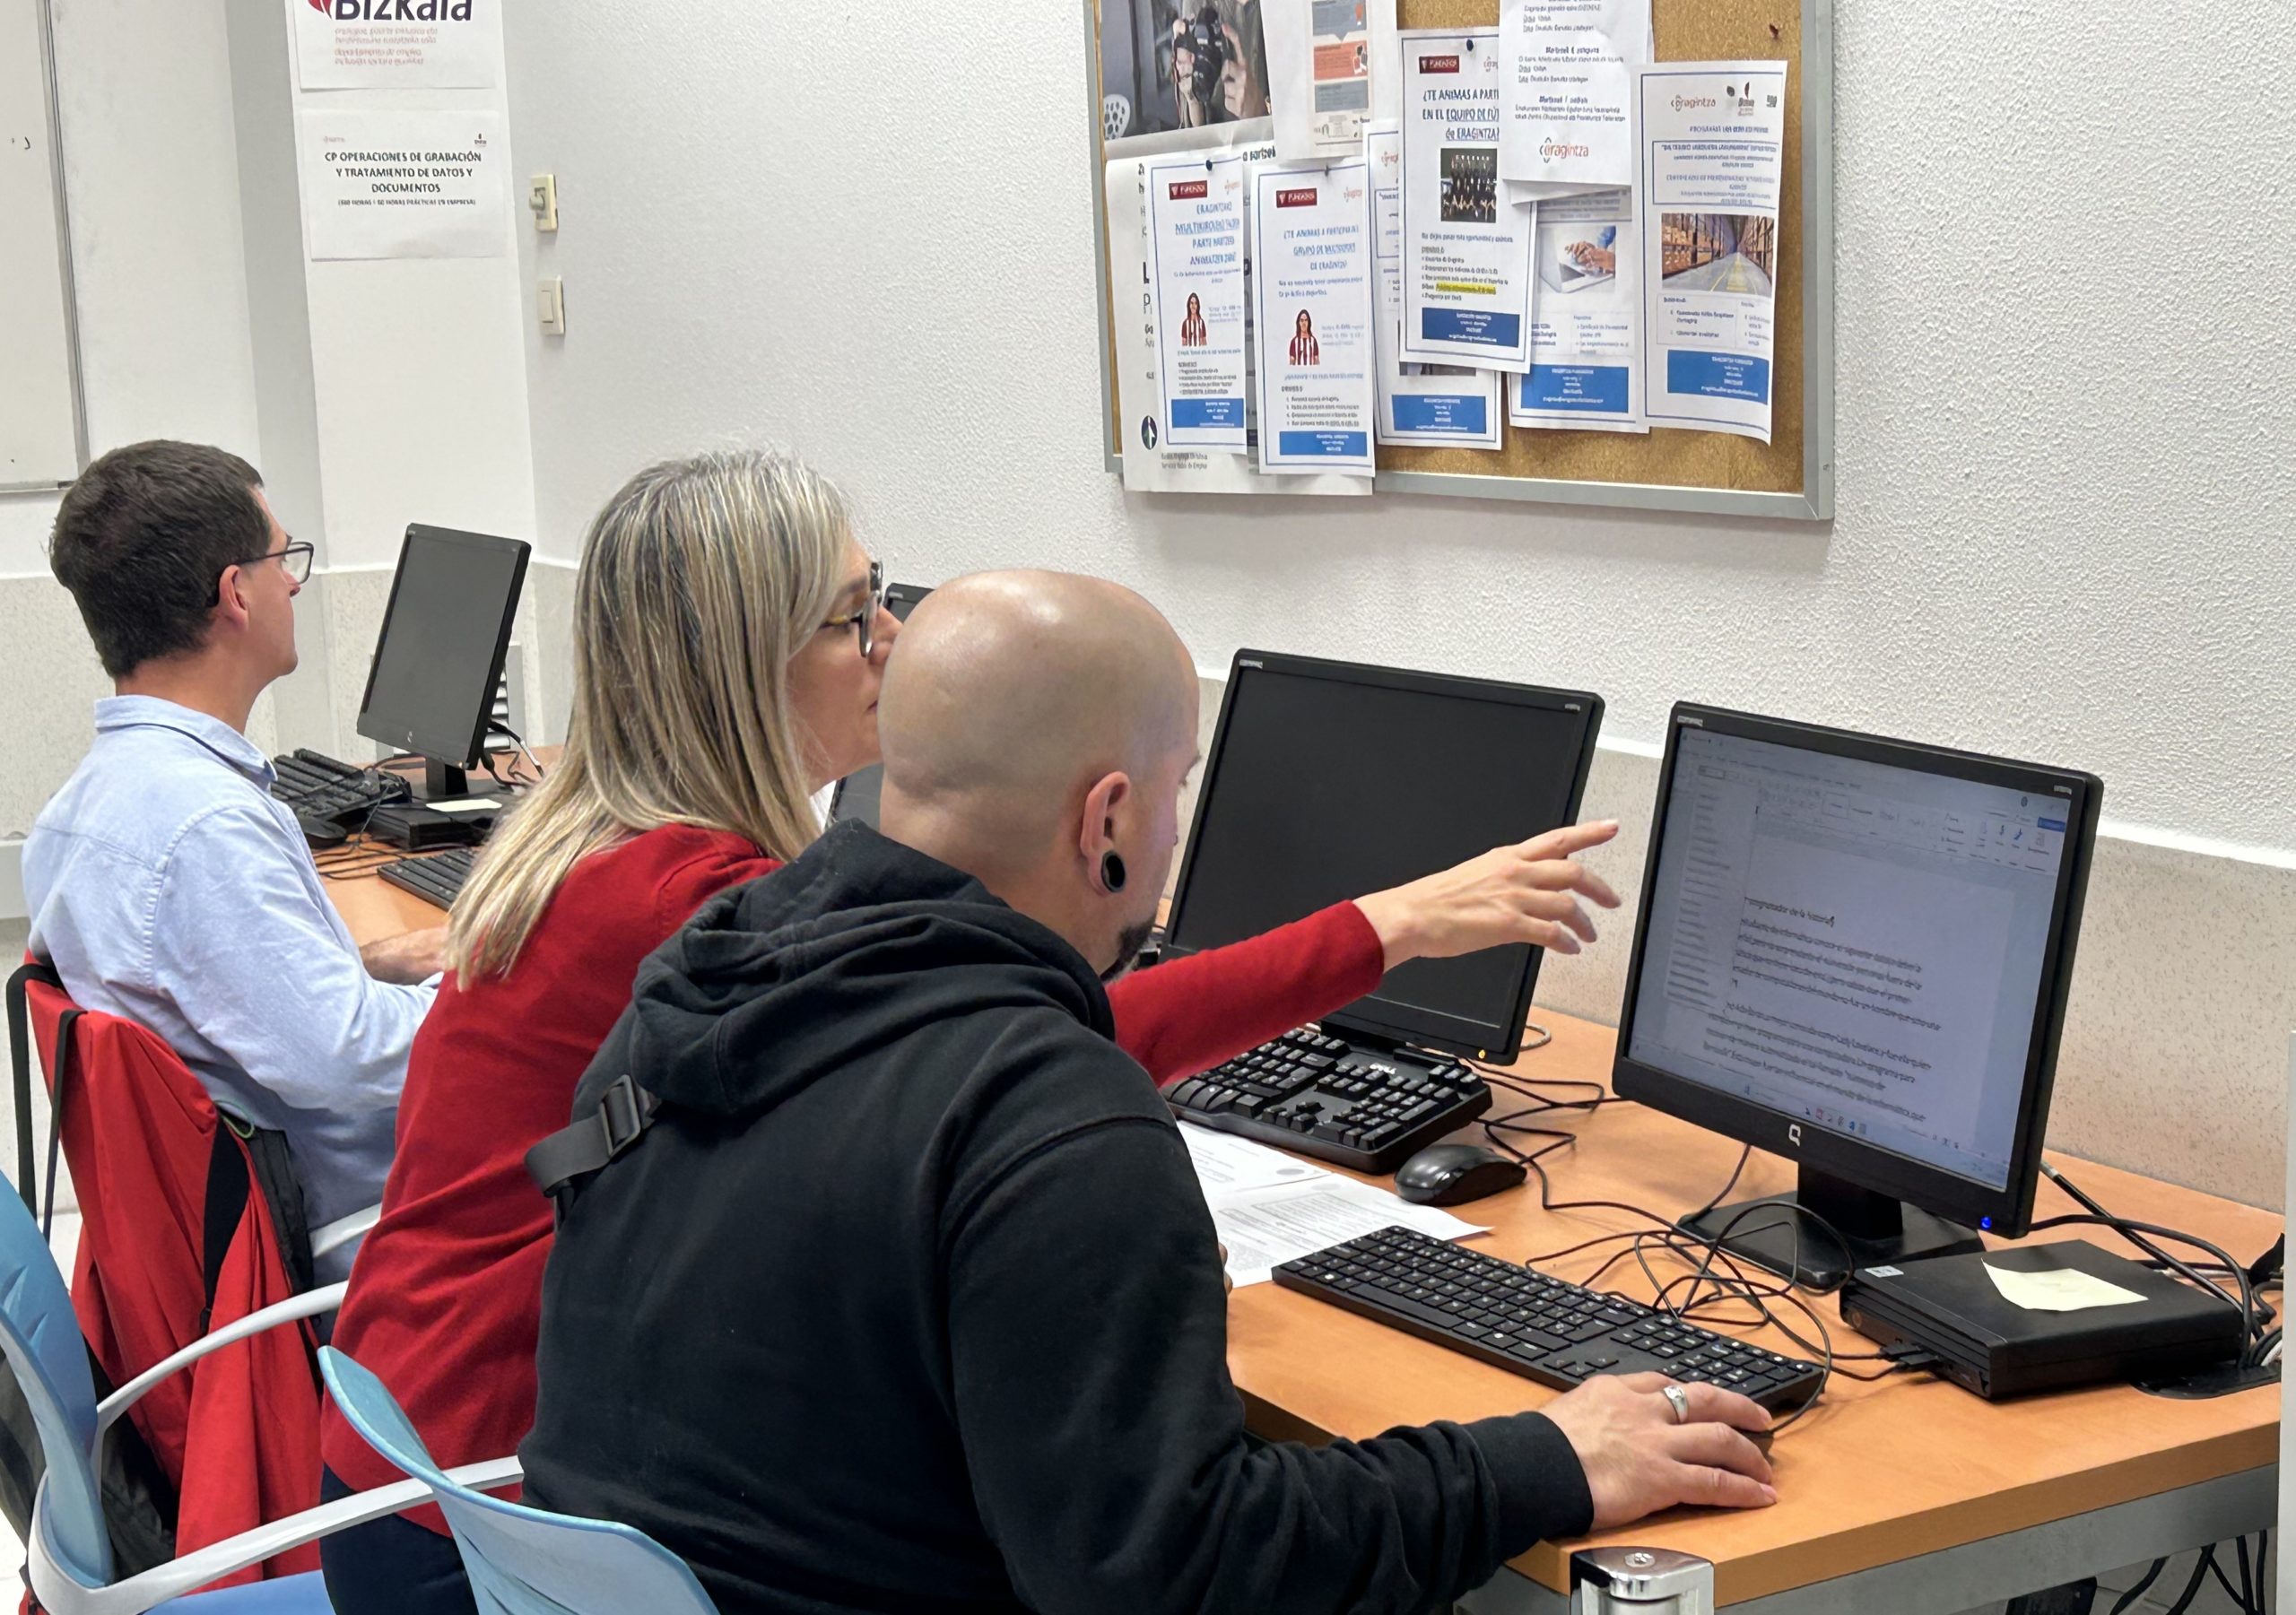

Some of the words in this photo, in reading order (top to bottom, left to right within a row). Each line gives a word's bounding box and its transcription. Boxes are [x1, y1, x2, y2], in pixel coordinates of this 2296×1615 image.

[1439, 90, 1471, 100] ANIMAS
[1473, 89, 1478, 100] A
[1422, 109, 1433, 120] EN
[1436, 109, 1444, 120] EL
[1447, 109, 1475, 121] EQUIPO
[1477, 109, 1485, 120] DE
[325, 152, 337, 162] CP
[340, 152, 407, 162] OPERACIONES
[410, 152, 422, 162] DE
[425, 151, 482, 162] GRABACIÓN
[336, 168, 343, 178] Y
[344, 168, 415, 178] TRATAMIENTO
[418, 168, 430, 178] DE
[432, 168, 465, 178] DATOS
[466, 168, 473, 178] Y
[371, 183, 441, 193] DOCUMENTOS
